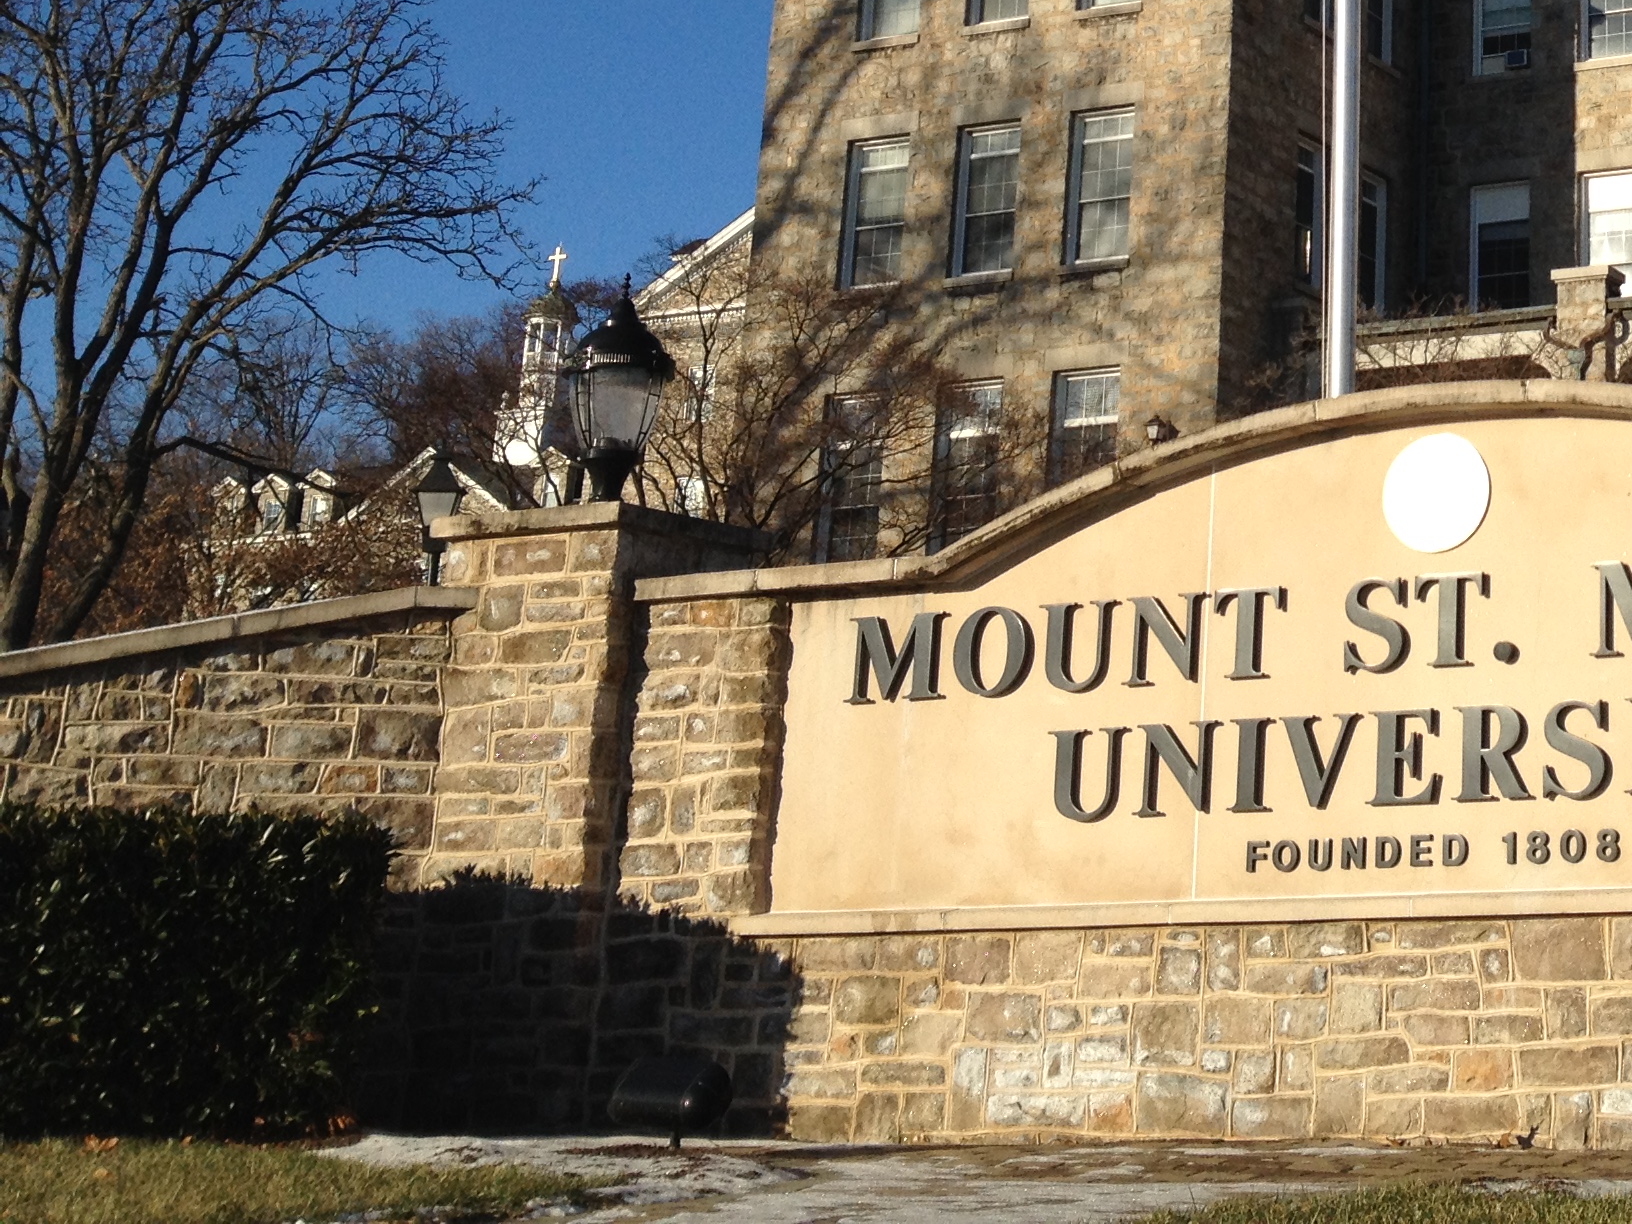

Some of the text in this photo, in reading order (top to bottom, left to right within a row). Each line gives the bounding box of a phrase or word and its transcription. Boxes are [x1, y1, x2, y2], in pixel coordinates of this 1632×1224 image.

[843, 585, 1288, 706] MOUNT
[1345, 572, 1522, 676] ST.
[1246, 829, 1623, 874] FOUNDED 1808
